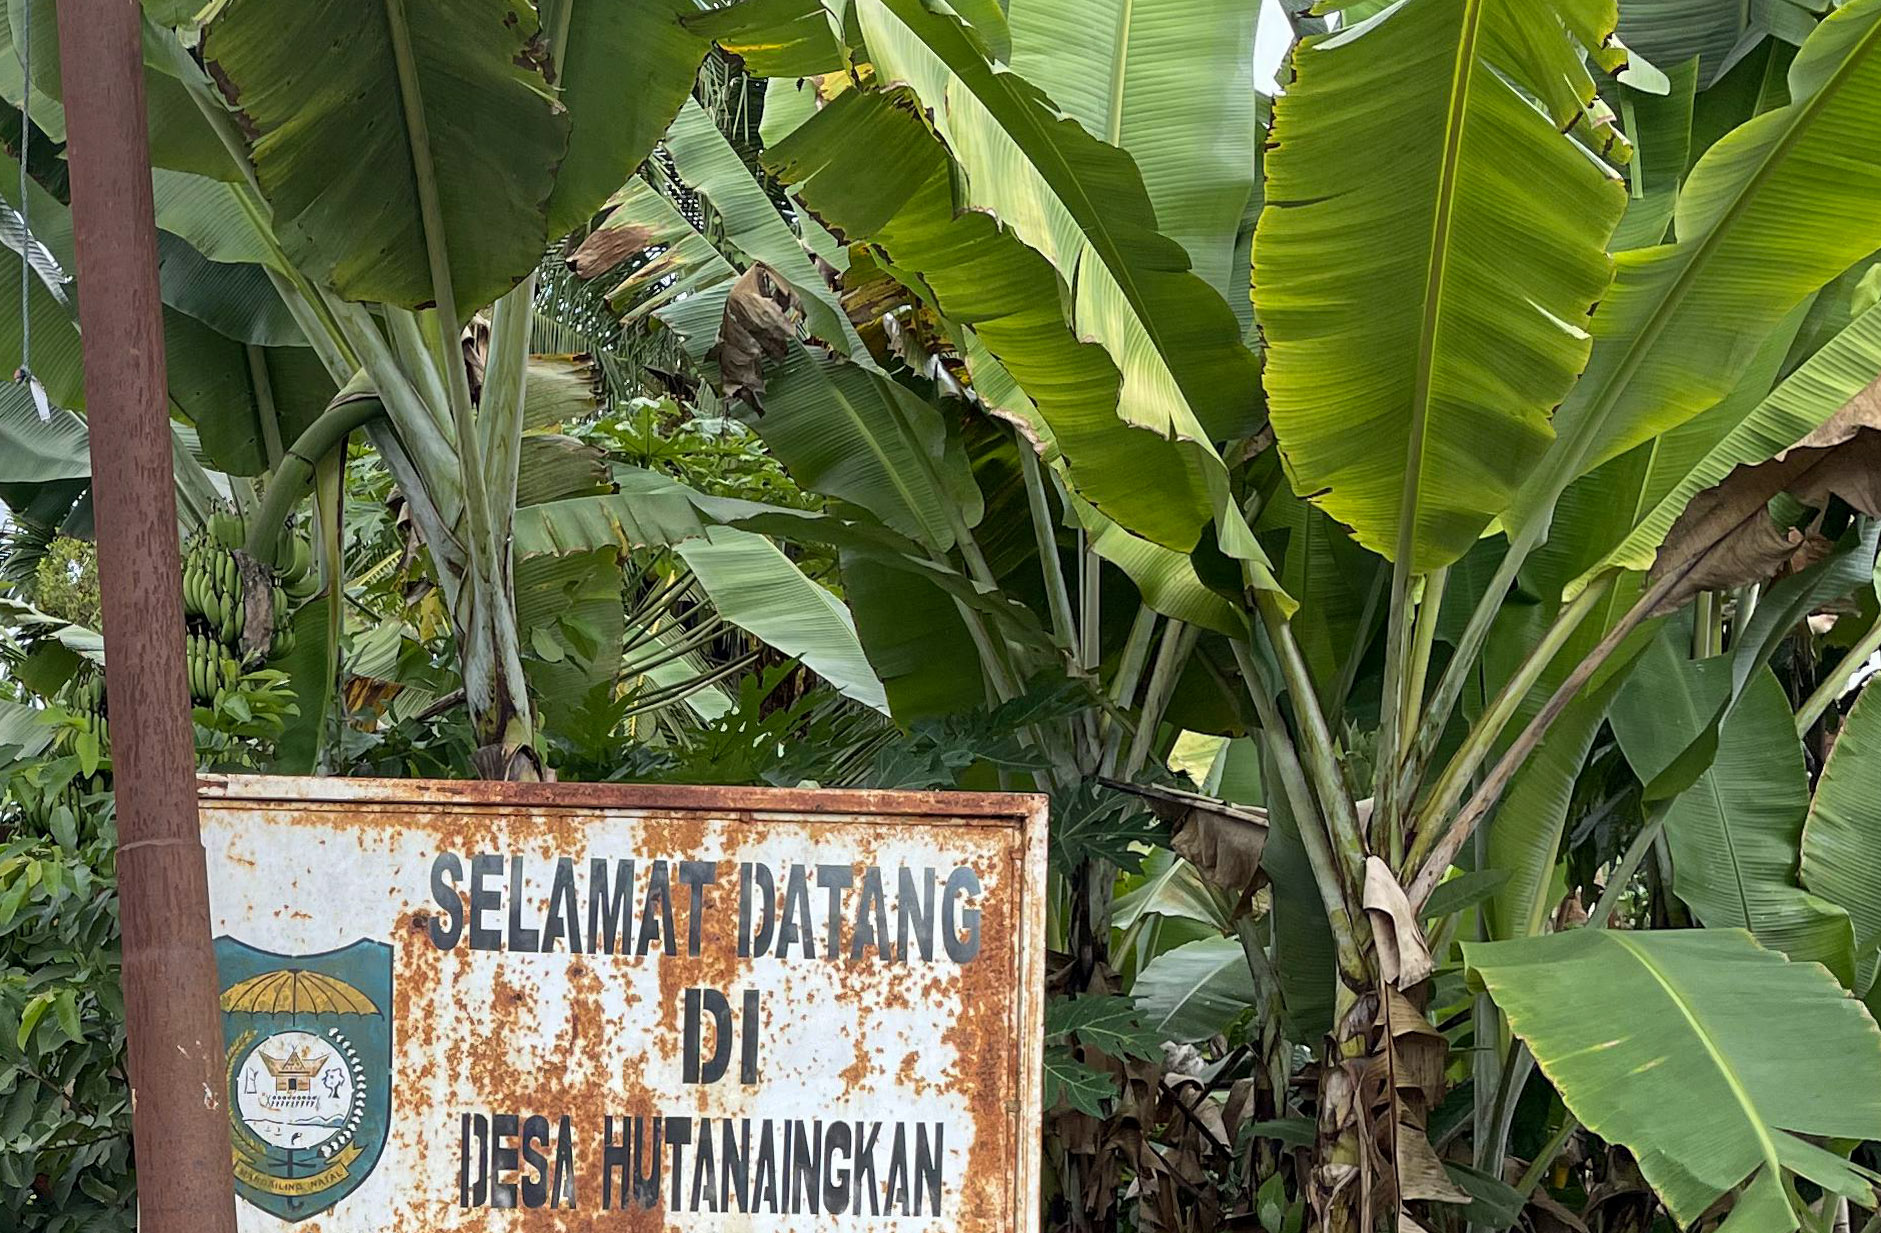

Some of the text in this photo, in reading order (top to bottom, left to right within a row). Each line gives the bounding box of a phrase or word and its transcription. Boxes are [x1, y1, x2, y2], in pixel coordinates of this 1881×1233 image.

[430, 853, 981, 964] SELAMAT DATANG
[683, 988, 760, 1085] DI
[460, 1113, 944, 1217] DESA HUTANAINGKAN
